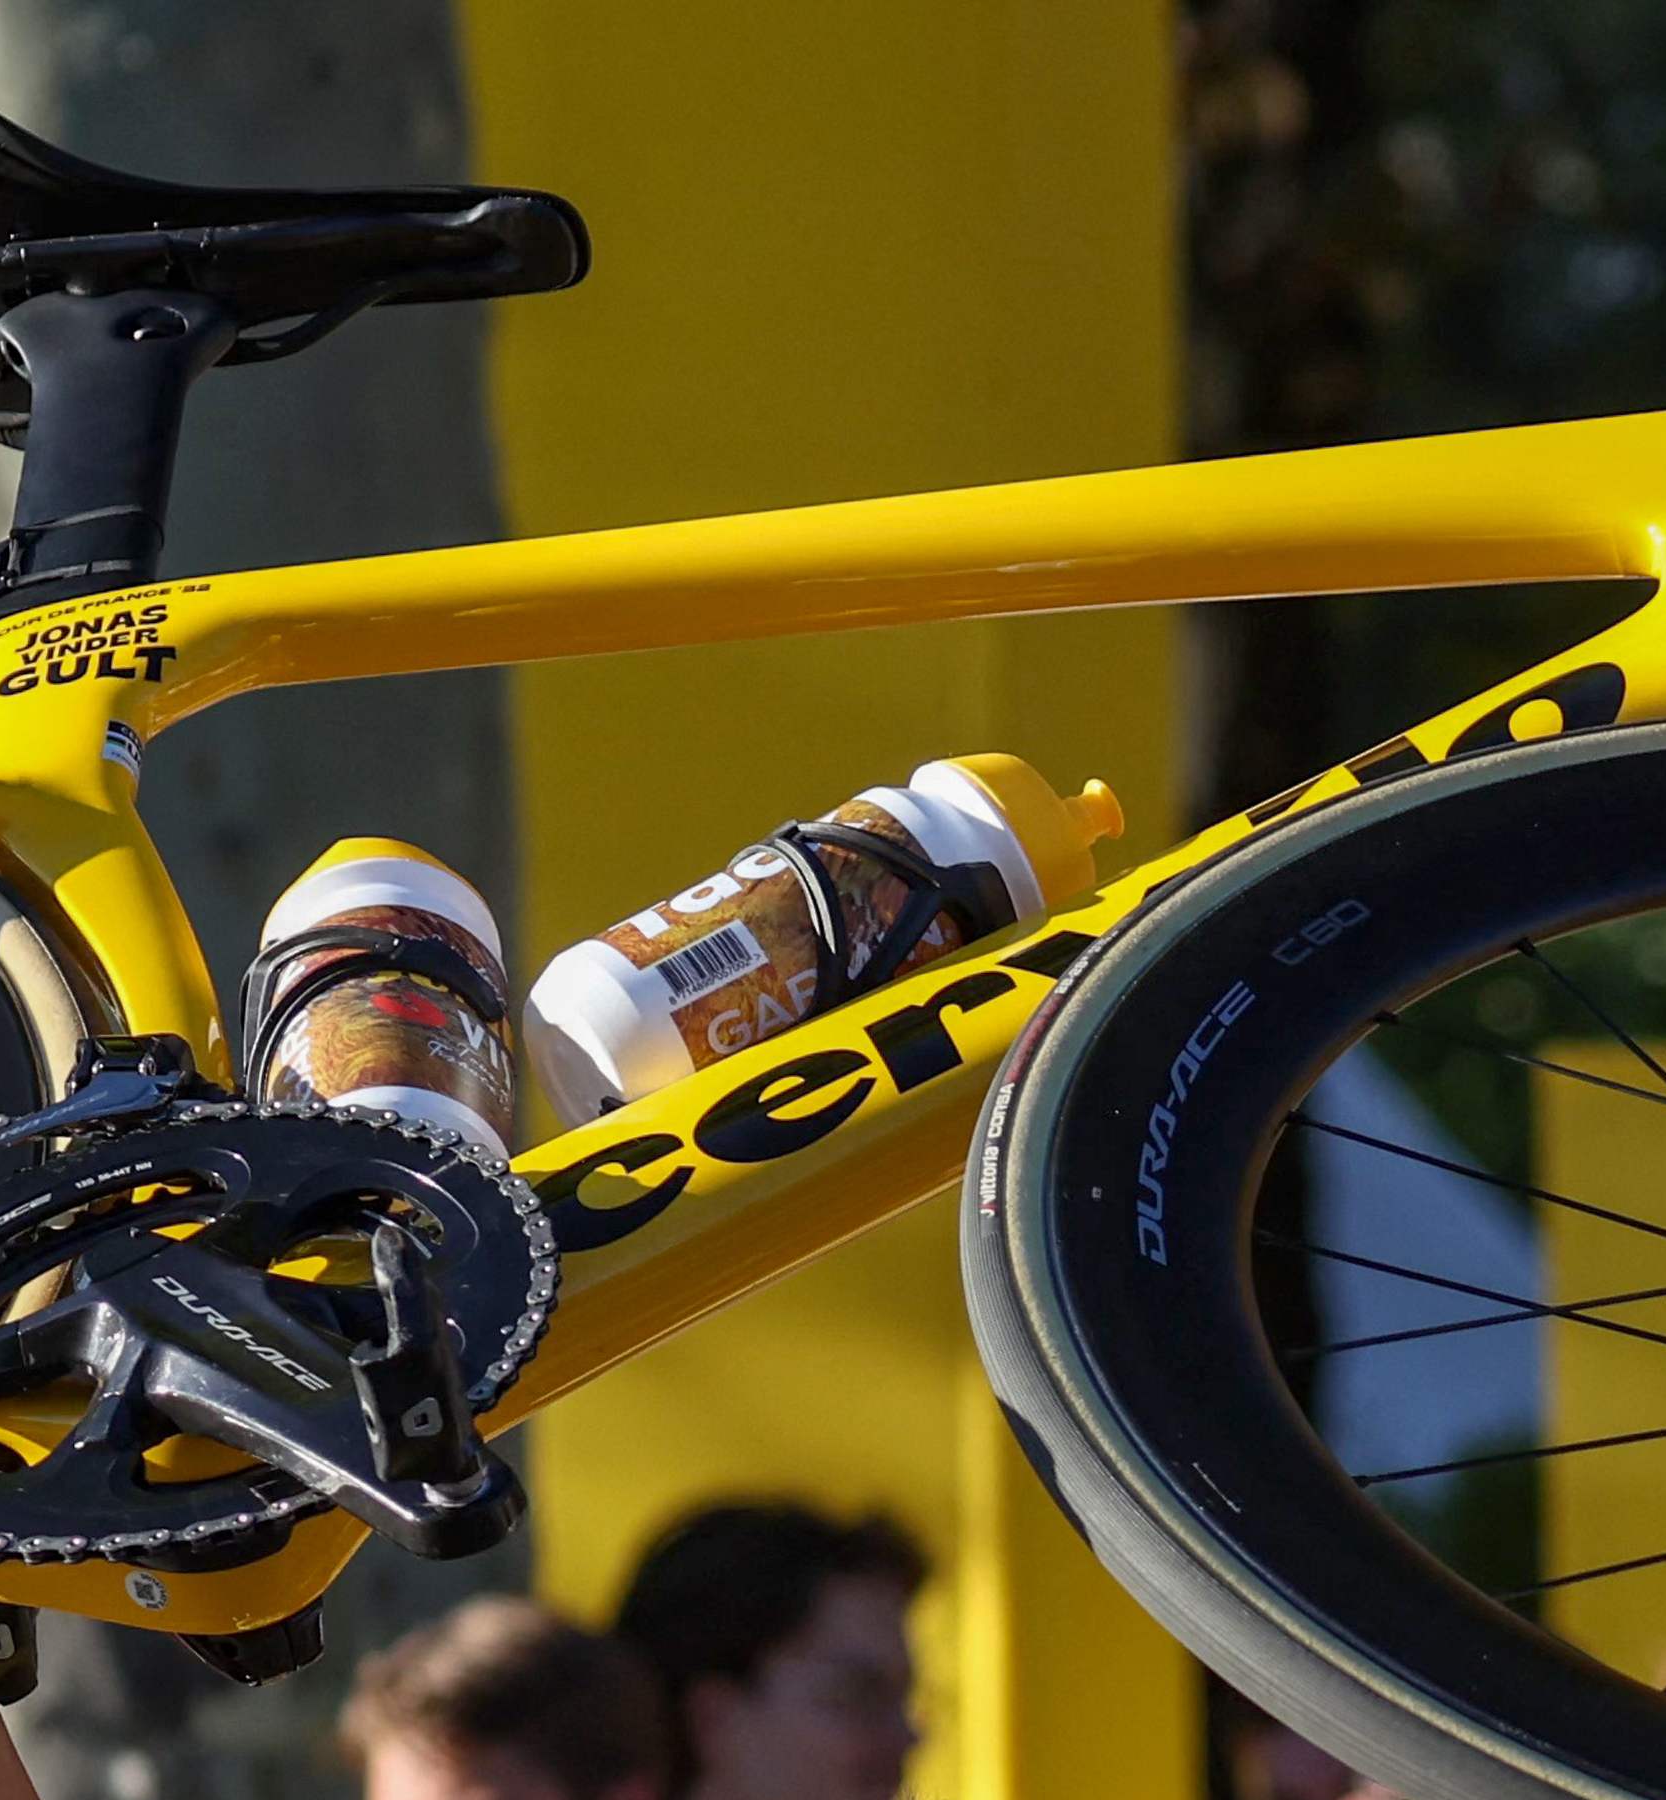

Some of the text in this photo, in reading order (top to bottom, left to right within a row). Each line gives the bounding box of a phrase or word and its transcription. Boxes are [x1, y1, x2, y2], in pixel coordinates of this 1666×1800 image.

[48, 605, 77, 618] DE
[83, 587, 172, 611] FRANCE
[15, 604, 169, 653] JONAS
[21, 627, 159, 665] VINDER
[1136, 980, 1257, 1267] DURA-ACE
[151, 1275, 332, 1392] DURA-ACE
